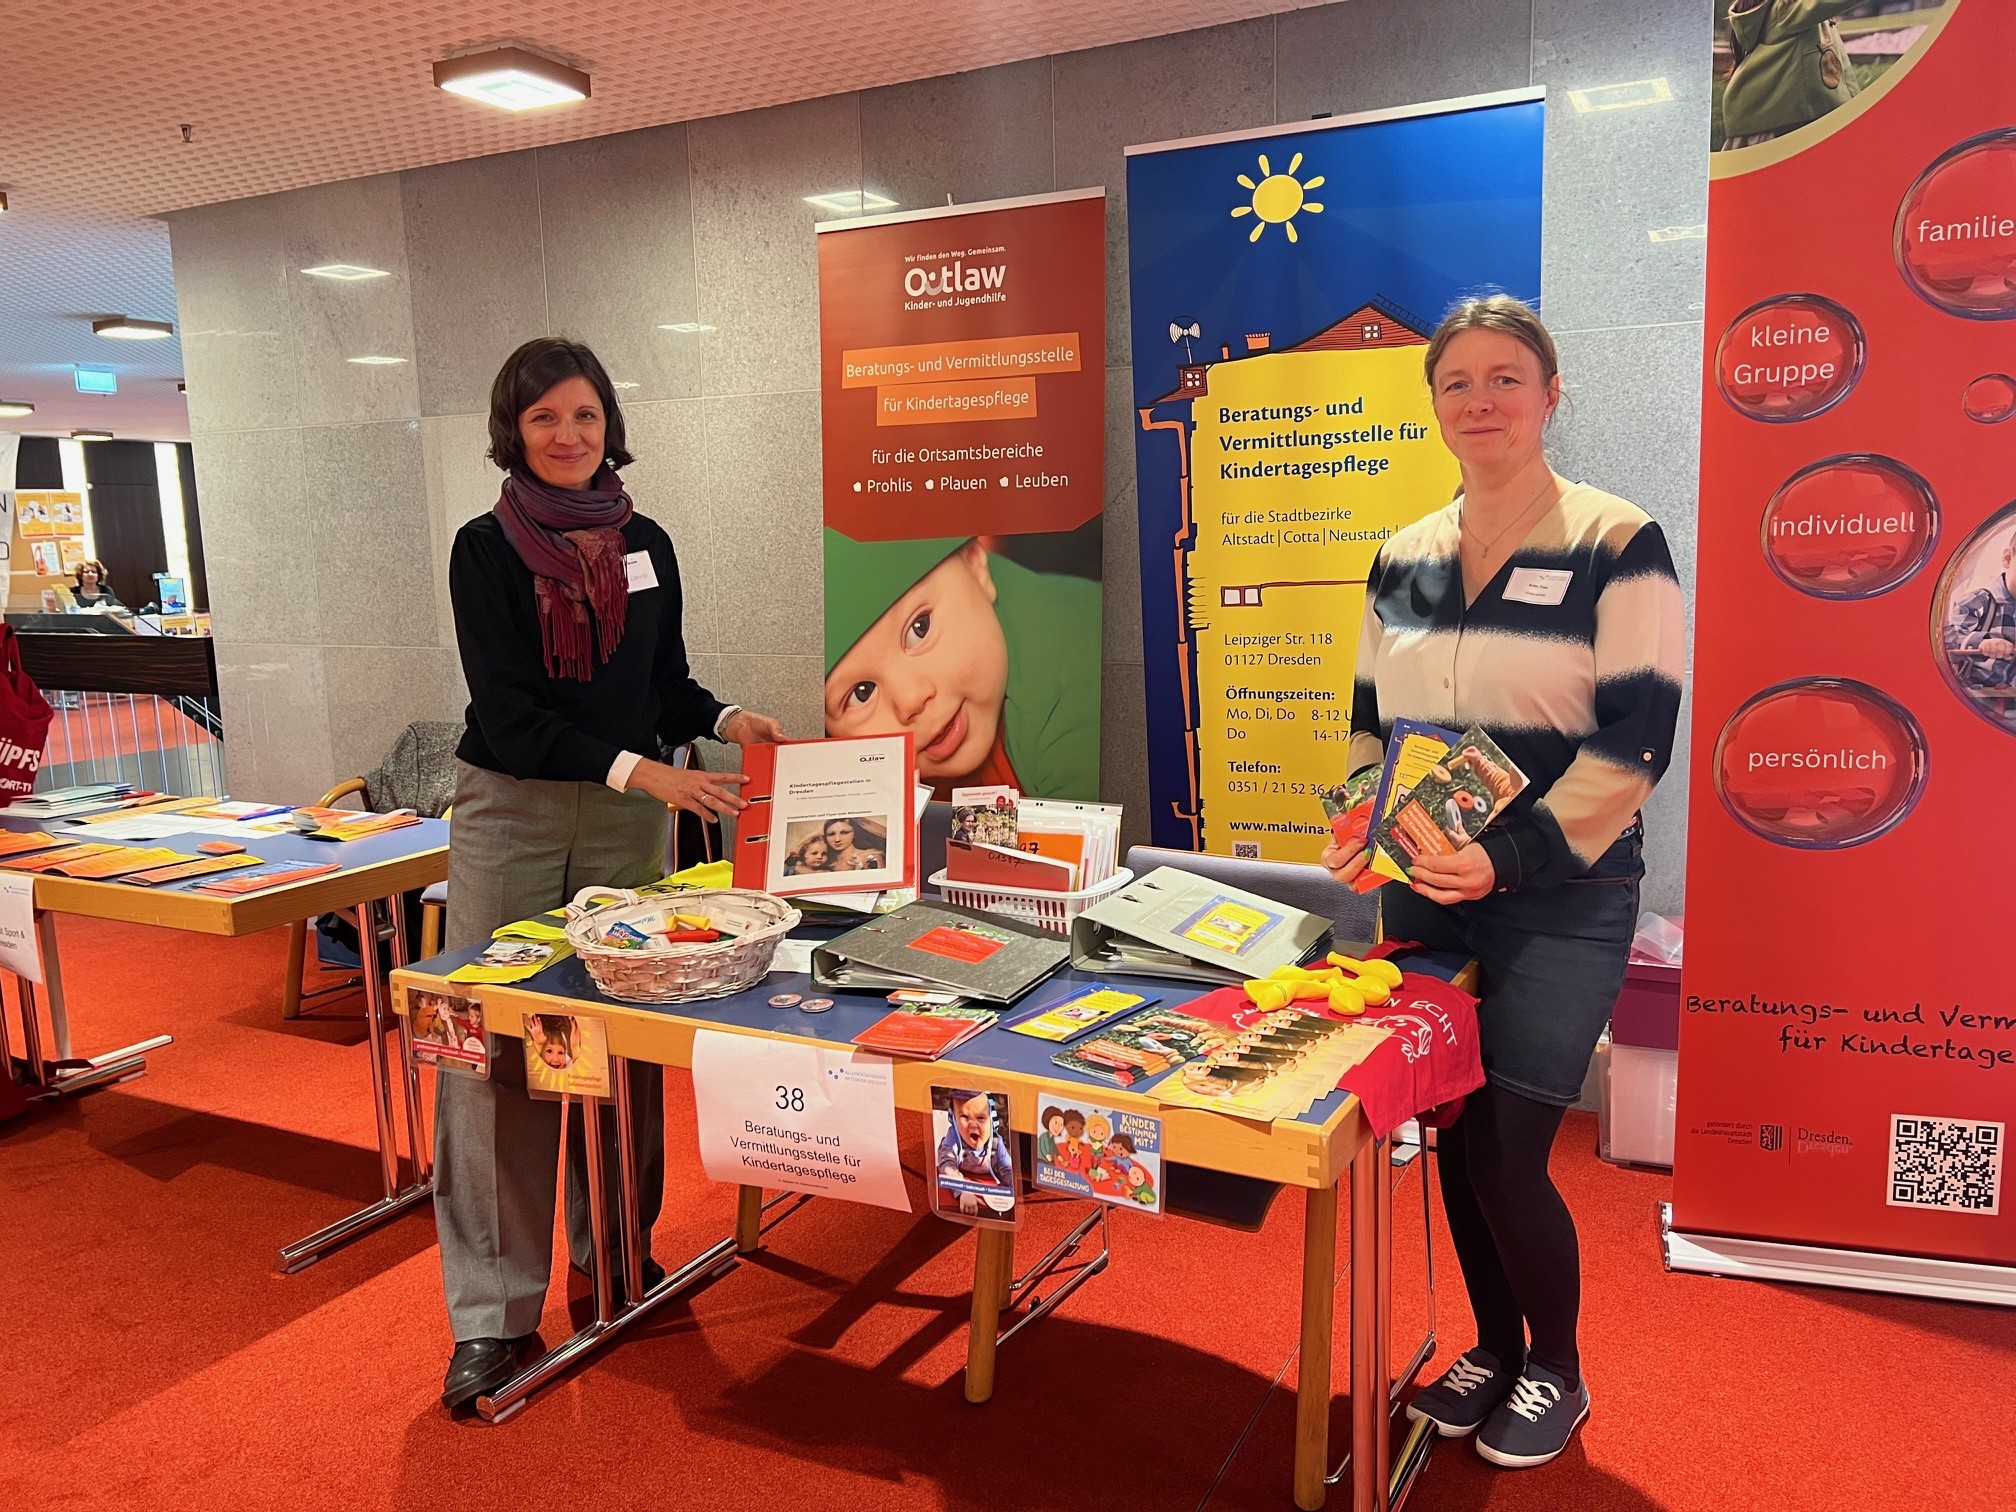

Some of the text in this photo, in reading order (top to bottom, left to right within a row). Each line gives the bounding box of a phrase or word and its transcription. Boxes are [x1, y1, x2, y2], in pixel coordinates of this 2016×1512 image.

[1917, 215, 2015, 243] familie
[904, 246, 1007, 263] Wir finden den Weg. Gemeinsam.
[904, 260, 1007, 297] Outlaw
[904, 292, 1007, 311] Kinder- und Jugendhilfe
[1751, 323, 1830, 348] kleine
[846, 346, 1075, 378] Beratungs- und Vermittlungsstelle
[1733, 362, 1835, 388] Gruppe
[882, 391, 1030, 412] für Kindertagespflege
[1219, 396, 1364, 424] Beratungs- und
[1219, 422, 1428, 452] Vermittlungsstelle für
[871, 442, 1044, 464] für die Ortsamtsbereiche
[1220, 454, 1390, 480] Kindertagespflege
[866, 472, 1070, 493] Prohlis Plauen Leuben
[1221, 506, 1353, 525] für die Stadtbezirke
[1771, 511, 1916, 537] individuell
[1221, 526, 1392, 546] Altstadt Cotta Neustadt
[1224, 632, 1333, 648] Leipziger Str. 118
[1224, 653, 1322, 666] 01127 Dresden
[1225, 685, 1336, 703] Öffnungszeiten:
[1226, 708, 1252, 721] Mo,
[1255, 707, 1273, 721] Di,
[1276, 708, 1296, 720] Do
[1311, 709, 1341, 721] 8-12
[1227, 728, 1349, 742] Do 14-17
[1228, 760, 1281, 774] Telefon:
[1748, 748, 1887, 772] persönlich
[1228, 781, 1325, 796] 0351 / 21 52 36
[4, 927, 20, 939] Sport
[20, 930, 26, 939] &
[1408, 1000, 1458, 1046] ECHT
[1685, 993, 2016, 1031] Beratungs- und Verm
[1778, 1025, 2016, 1070] für Kindertage
[774, 1085, 805, 1112] 38
[744, 1120, 841, 1147] Beratungs- und
[1735, 1121, 1753, 1130] durch
[730, 1135, 861, 1168] Vermittlungsstelle für
[741, 1155, 857, 1184] Kindertagespflege
